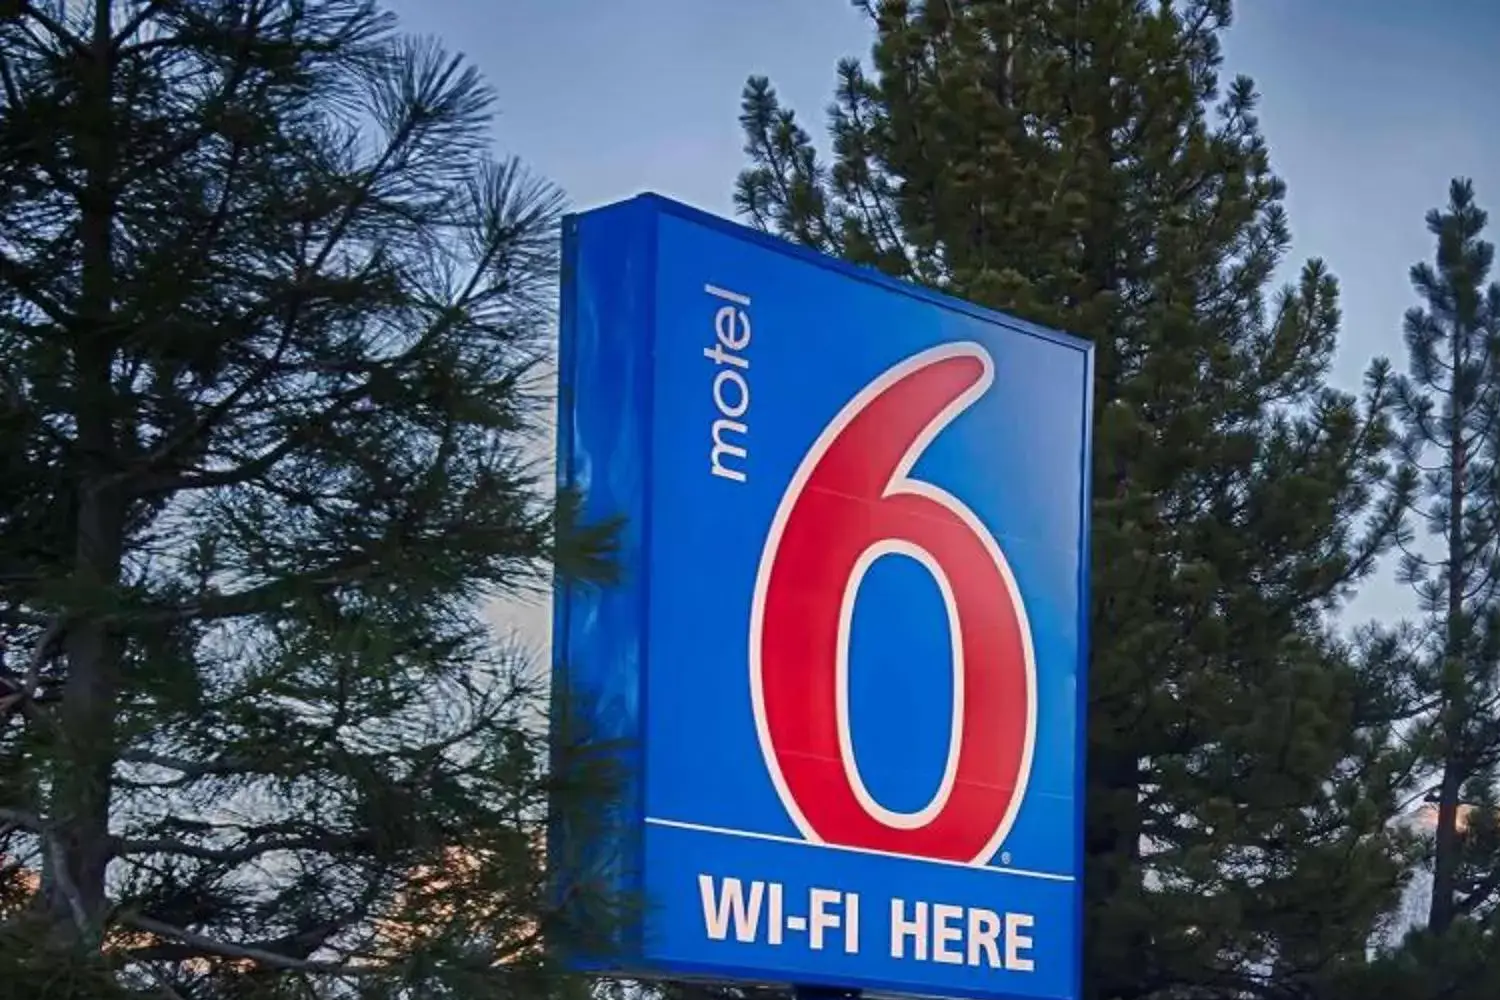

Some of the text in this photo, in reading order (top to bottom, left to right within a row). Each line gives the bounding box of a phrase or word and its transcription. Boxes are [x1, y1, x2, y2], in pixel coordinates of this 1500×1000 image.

[704, 284, 751, 482] motel
[749, 341, 1038, 866] 6
[698, 874, 1035, 971] WI-FI HERE
